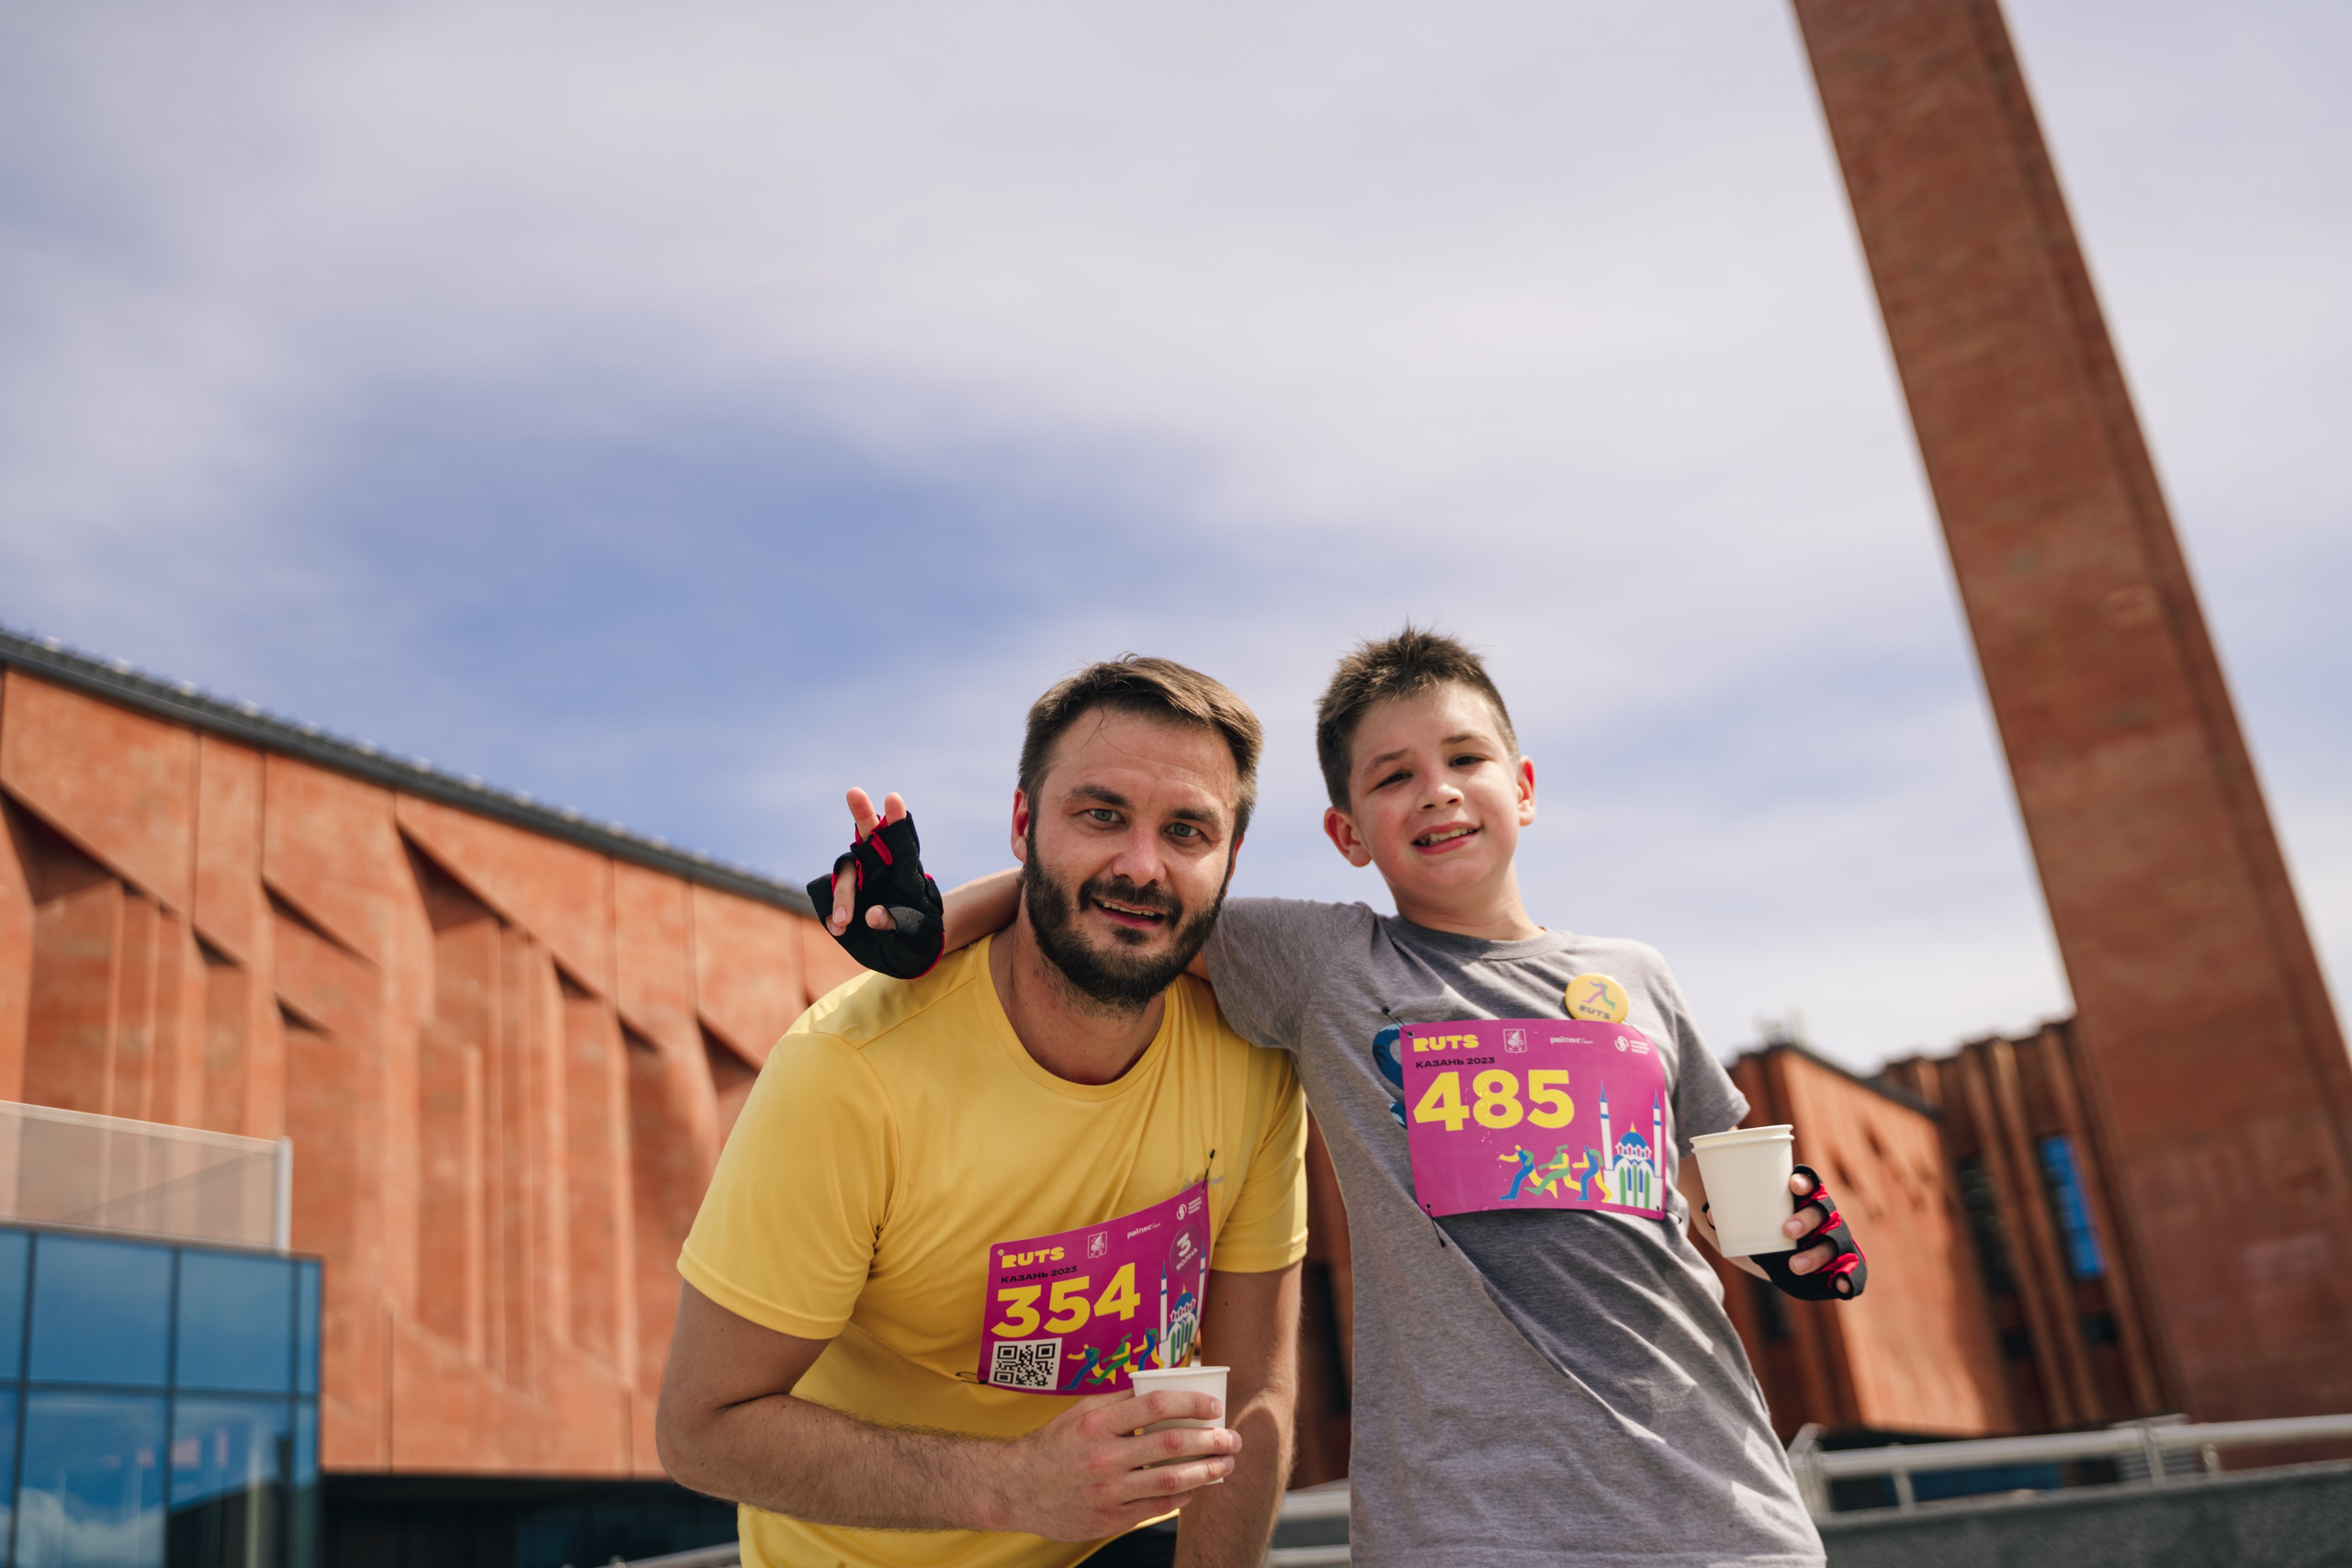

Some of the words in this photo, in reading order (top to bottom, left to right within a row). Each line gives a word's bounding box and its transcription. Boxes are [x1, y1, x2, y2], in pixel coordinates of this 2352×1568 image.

[1579, 1004, 1611, 1020] RUTS
[1413, 1034, 1479, 1053] RUTS
[1416, 1057, 1464, 1068] КАЗАНЬ
[1466, 1056, 1495, 1065] 2023
[1412, 1069, 1575, 1131] 485
[1177, 1232, 1192, 1258] 3
[1001, 1247, 1065, 1269] RUTS
[1176, 1247, 1198, 1271] ВОЛНА
[1001, 1271, 1049, 1283] КАЗАНЬ
[1050, 1265, 1078, 1277] 2023
[990, 1262, 1141, 1337] 354
